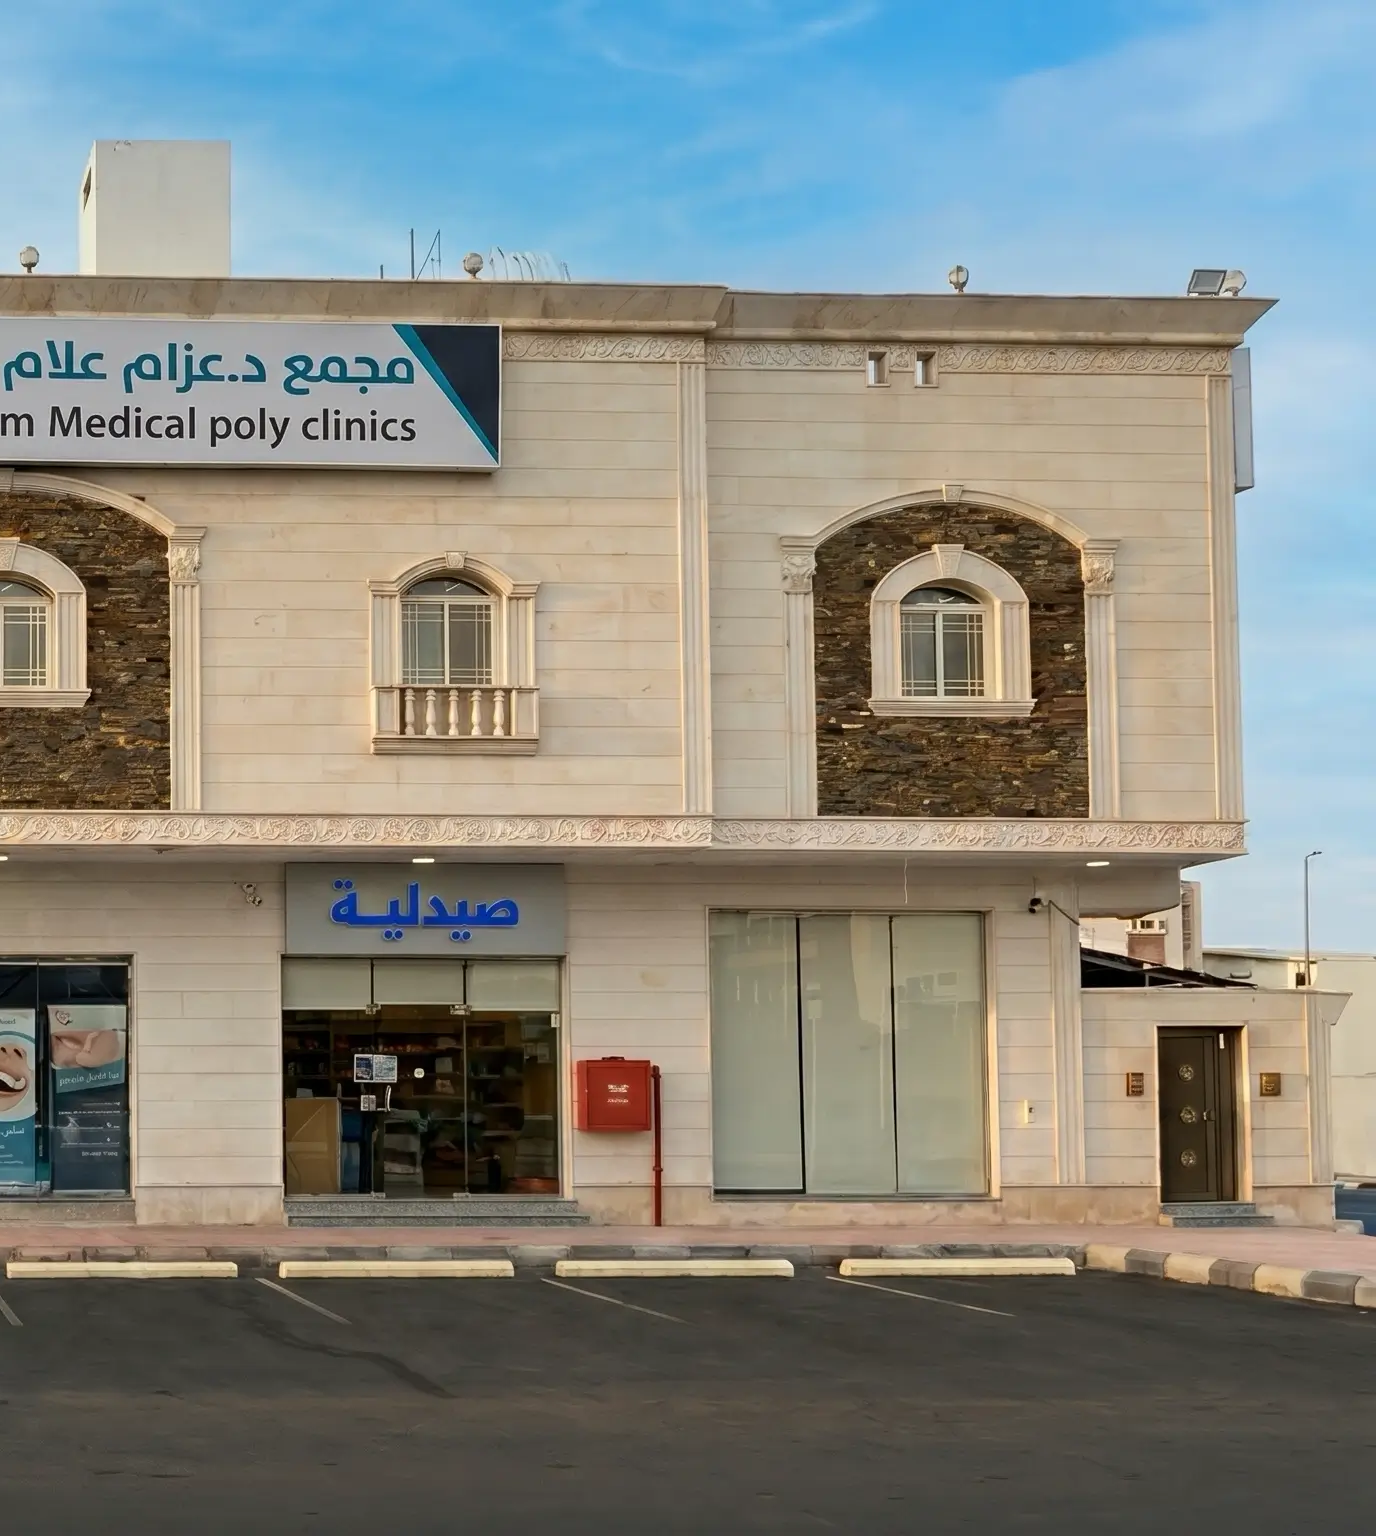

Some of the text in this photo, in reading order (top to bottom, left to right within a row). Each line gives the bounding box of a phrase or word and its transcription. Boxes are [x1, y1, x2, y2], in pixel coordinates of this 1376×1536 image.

[3, 339, 107, 392] علام
[283, 353, 415, 396] مجمع
[48, 405, 197, 439] Medical
[209, 407, 291, 450] poly
[300, 408, 417, 442] clinics
[329, 878, 520, 942] صيدلية
